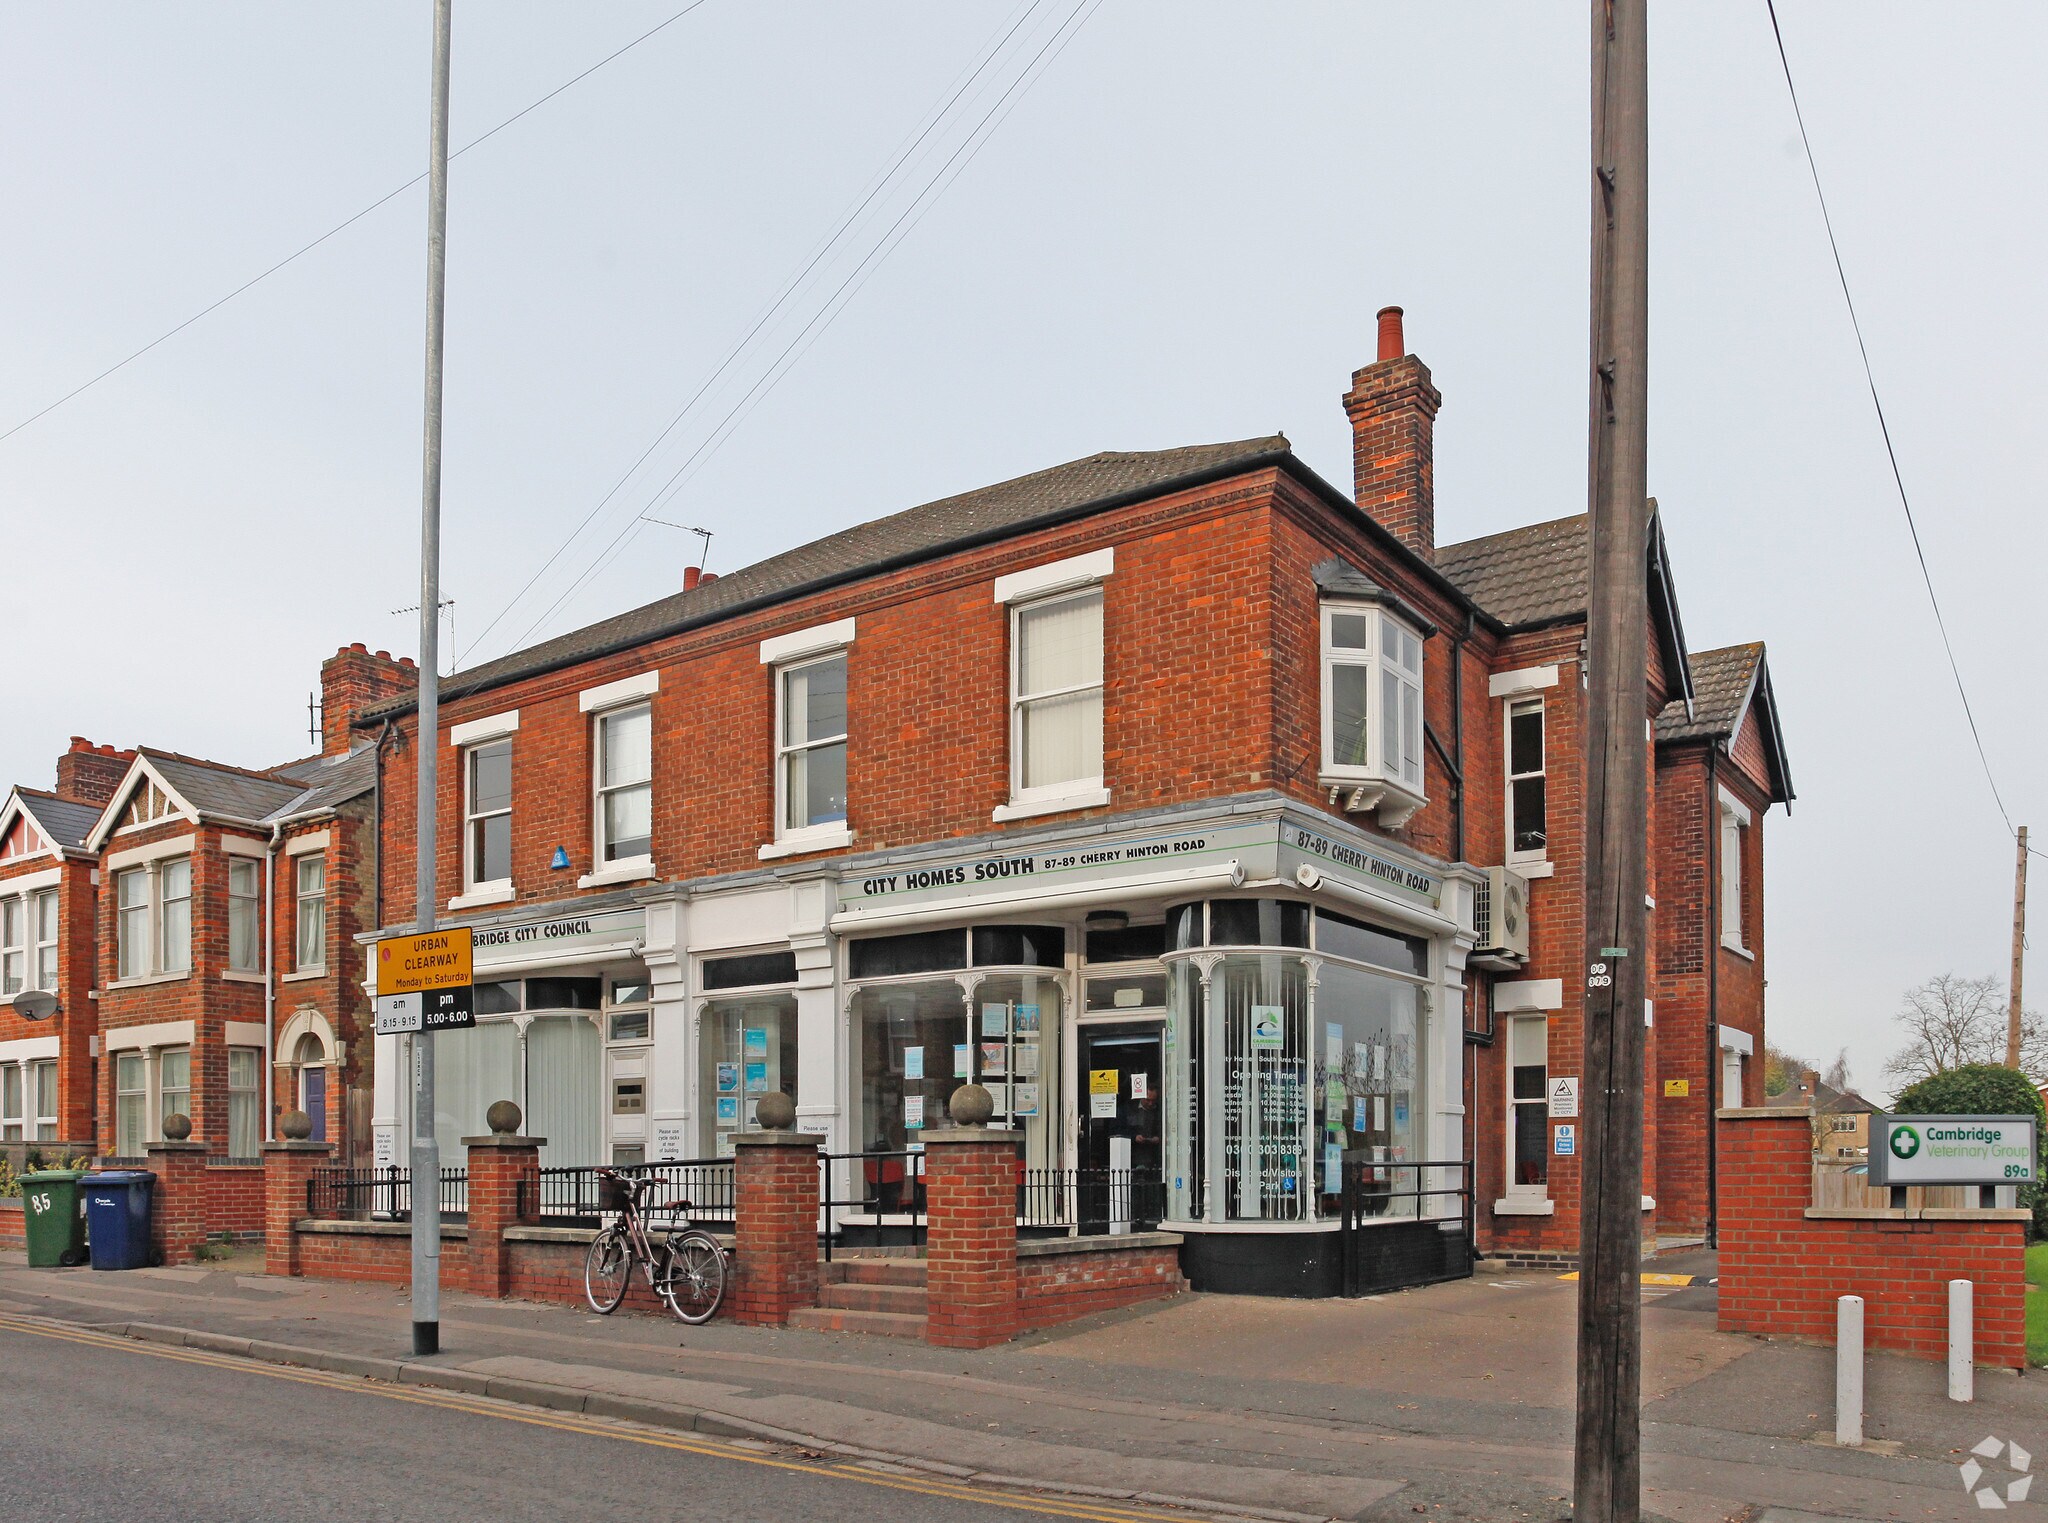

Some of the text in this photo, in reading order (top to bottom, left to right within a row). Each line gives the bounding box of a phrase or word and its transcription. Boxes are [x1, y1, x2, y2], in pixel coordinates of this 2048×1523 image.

[1044, 839, 1206, 869] 87-89 CHERRY HINTON ROAD
[1298, 831, 1430, 893] 87-89 CHERRY HINTON ROAD
[863, 857, 1034, 895] CITY HOMES SOUTH
[515, 926, 538, 942] CITY
[543, 920, 592, 938] COUNCIL
[413, 936, 448, 952] URBAN
[404, 953, 458, 971] CLEARWAY
[395, 971, 469, 988] Monday to Saturday
[393, 1000, 406, 1009] am
[440, 994, 454, 1007] pm
[1927, 1127, 2002, 1144] Cambridge
[1926, 1144, 2030, 1160] Veterinary Group
[2004, 1164, 2029, 1178] 89a
[31, 1193, 51, 1215] 85
